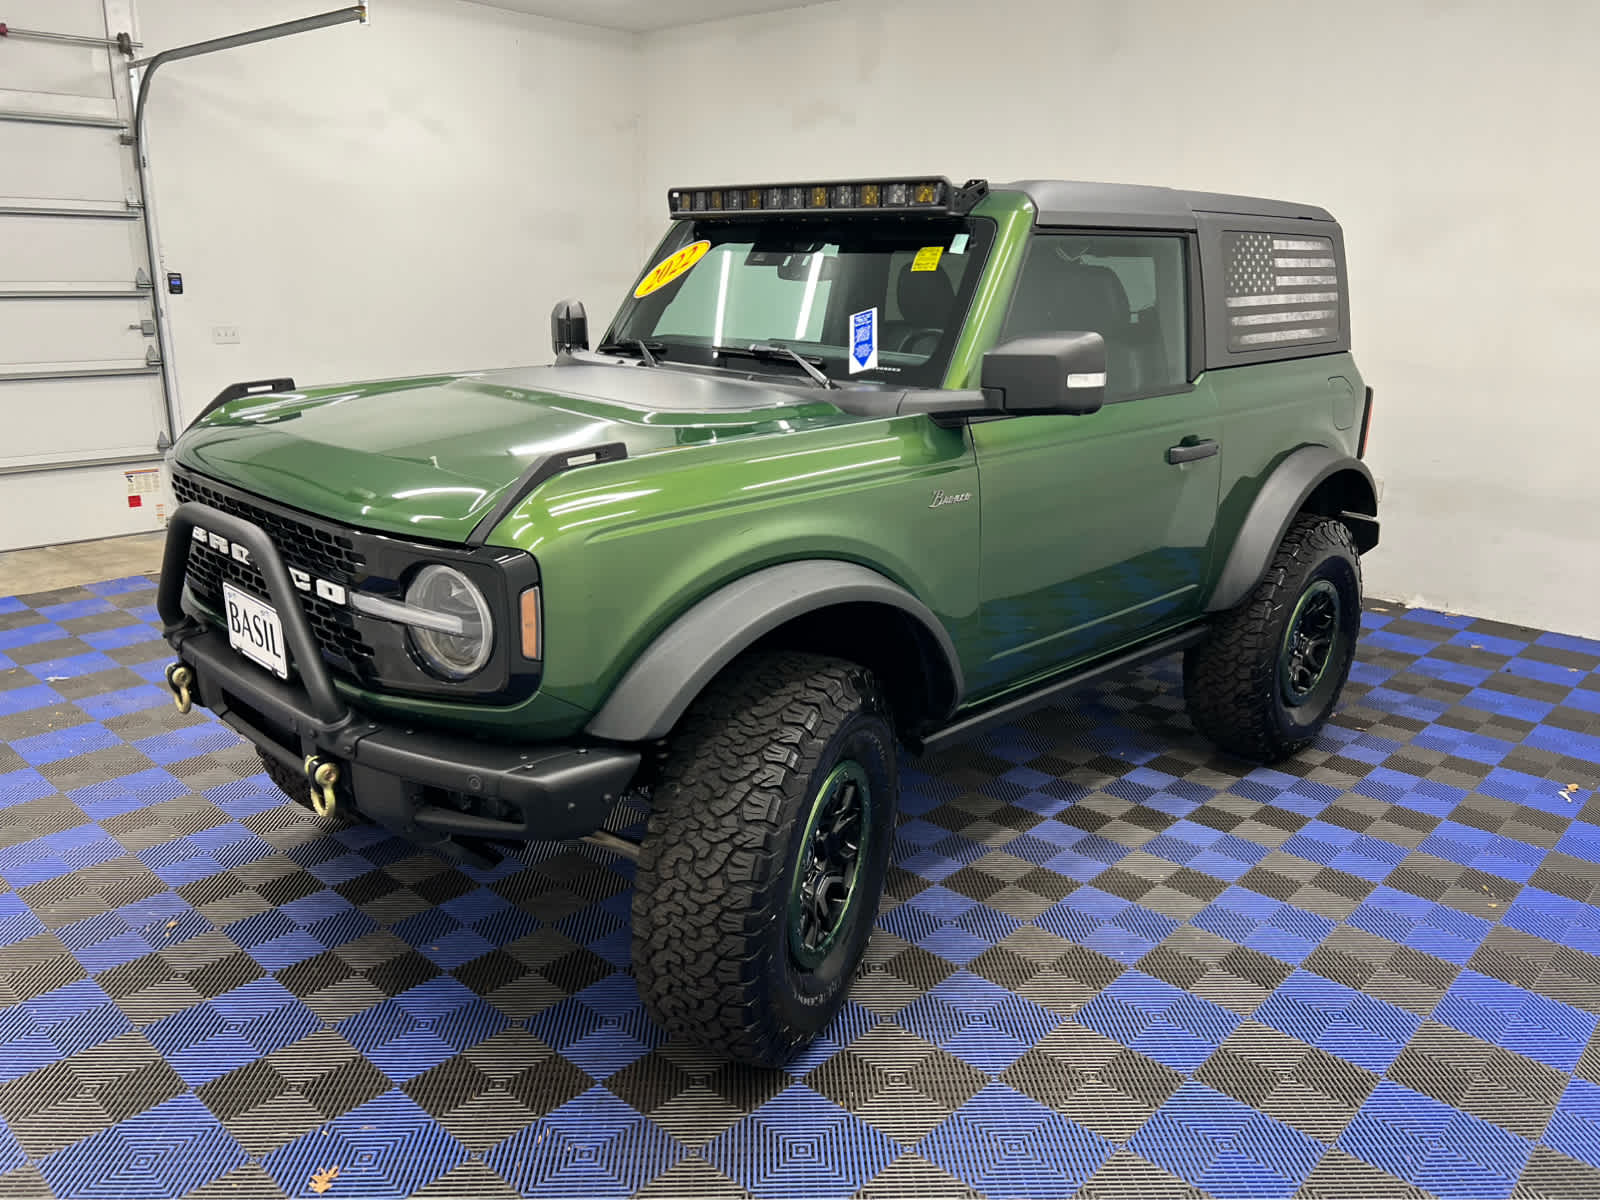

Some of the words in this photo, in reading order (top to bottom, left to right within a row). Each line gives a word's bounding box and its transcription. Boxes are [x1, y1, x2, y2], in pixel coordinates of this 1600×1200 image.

[644, 244, 699, 292] 2022
[192, 526, 346, 606] BROCO
[229, 600, 282, 659] BASIL
